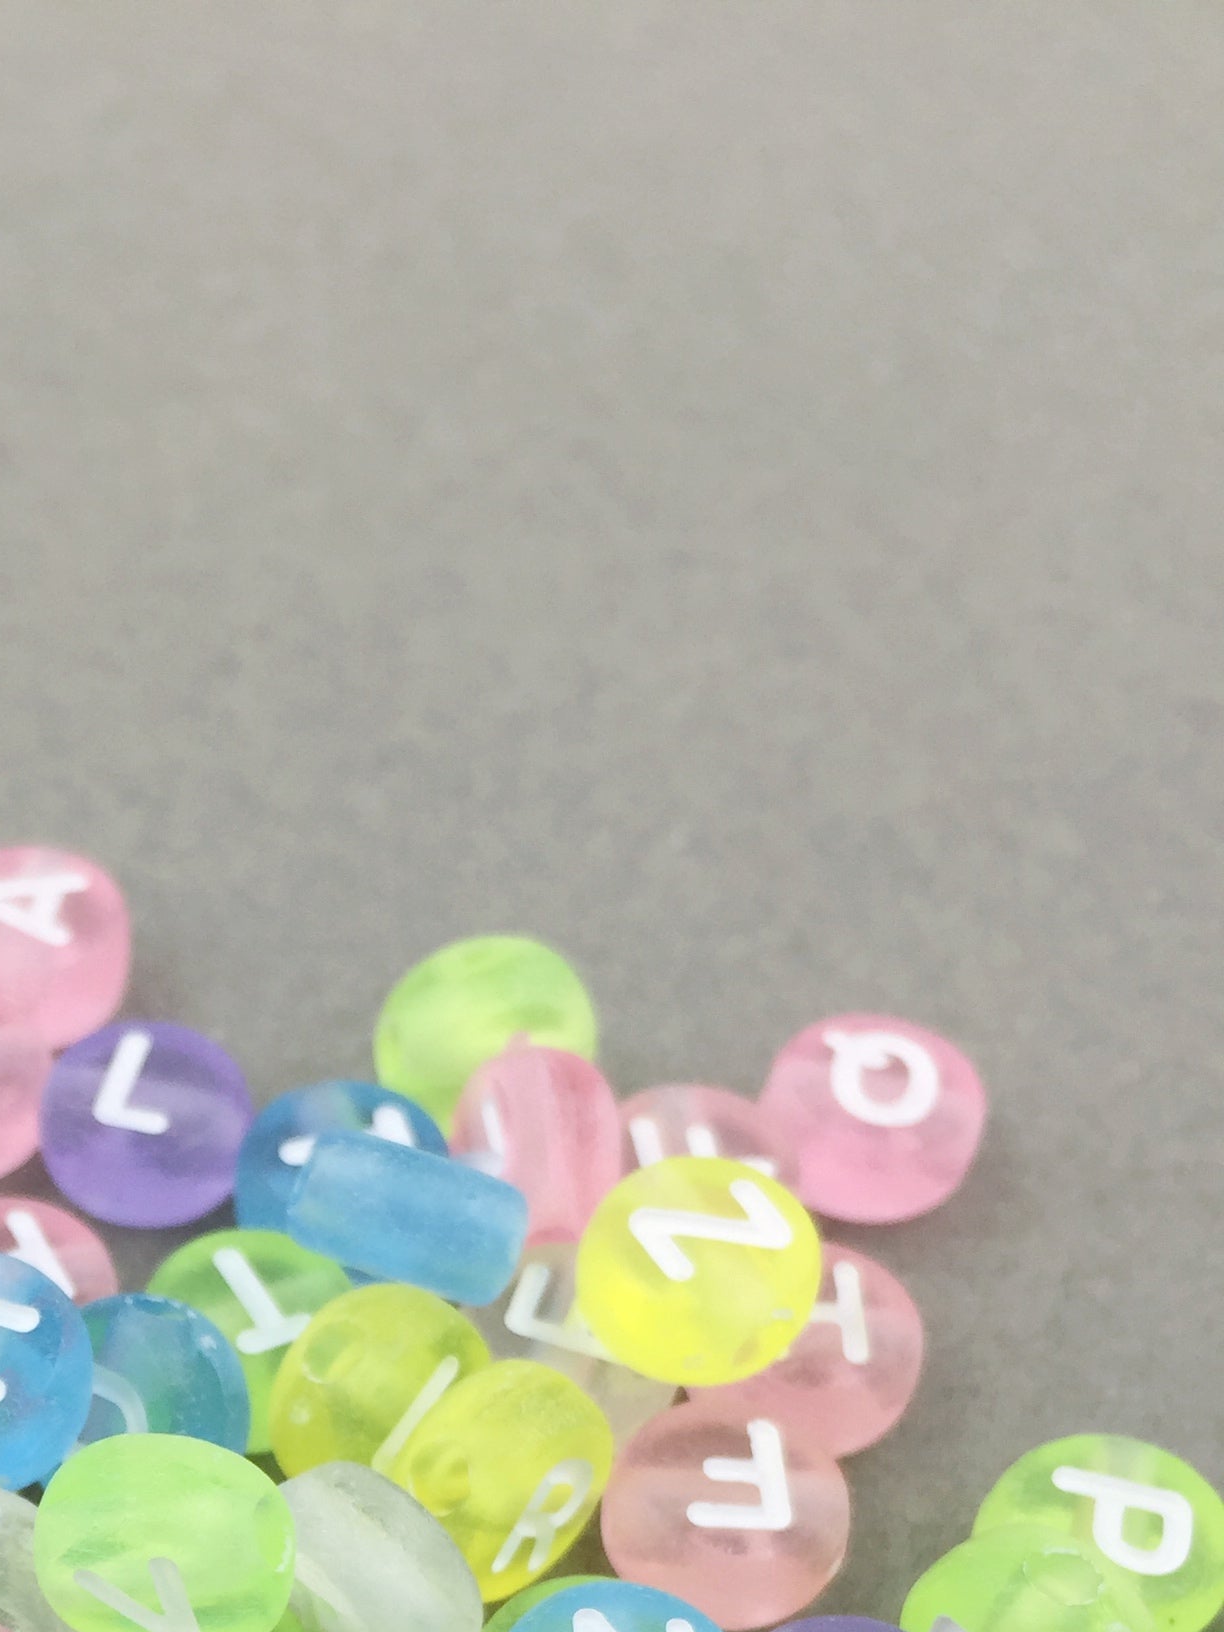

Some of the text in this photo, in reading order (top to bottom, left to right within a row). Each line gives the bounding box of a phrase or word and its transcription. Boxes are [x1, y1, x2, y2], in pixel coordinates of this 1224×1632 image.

[95, 1034, 166, 1132] L
[824, 1031, 940, 1126] Q
[490, 1458, 594, 1574] R
[687, 1420, 793, 1530] F
[1053, 1467, 1192, 1574] P
